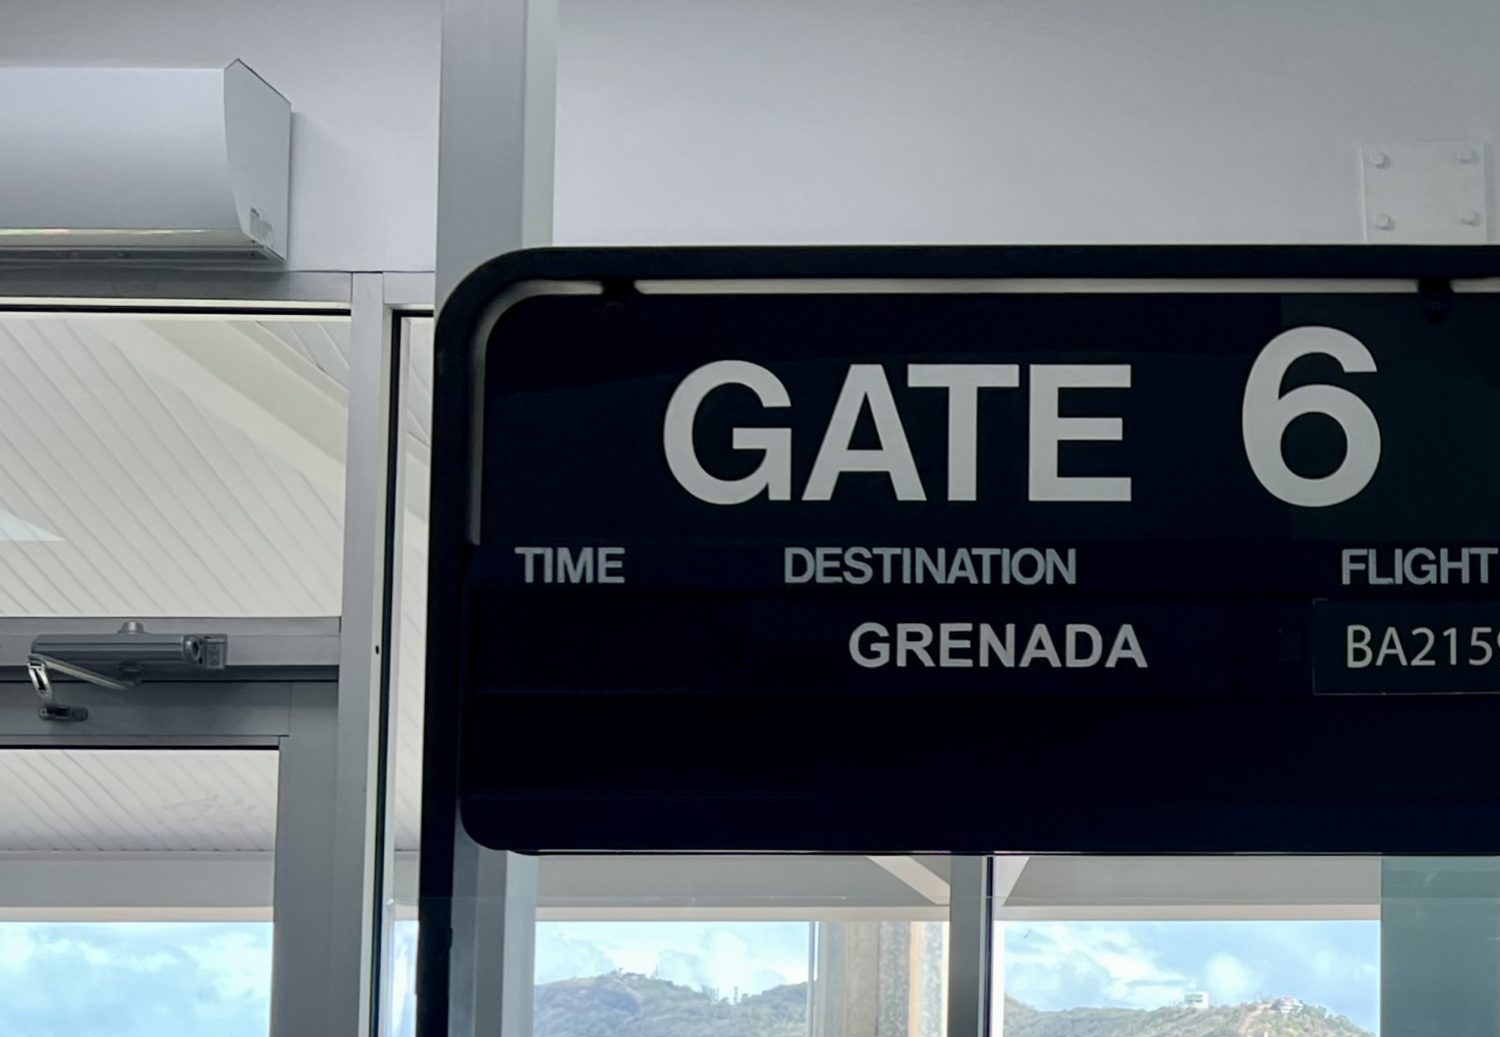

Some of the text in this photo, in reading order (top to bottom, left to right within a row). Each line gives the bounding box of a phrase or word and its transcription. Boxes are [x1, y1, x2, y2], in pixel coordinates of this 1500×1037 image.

[664, 326, 1380, 507] GATE 6
[515, 547, 1498, 584] TIME DESTINATION FLIGHT
[850, 623, 1147, 667] GRENADA
